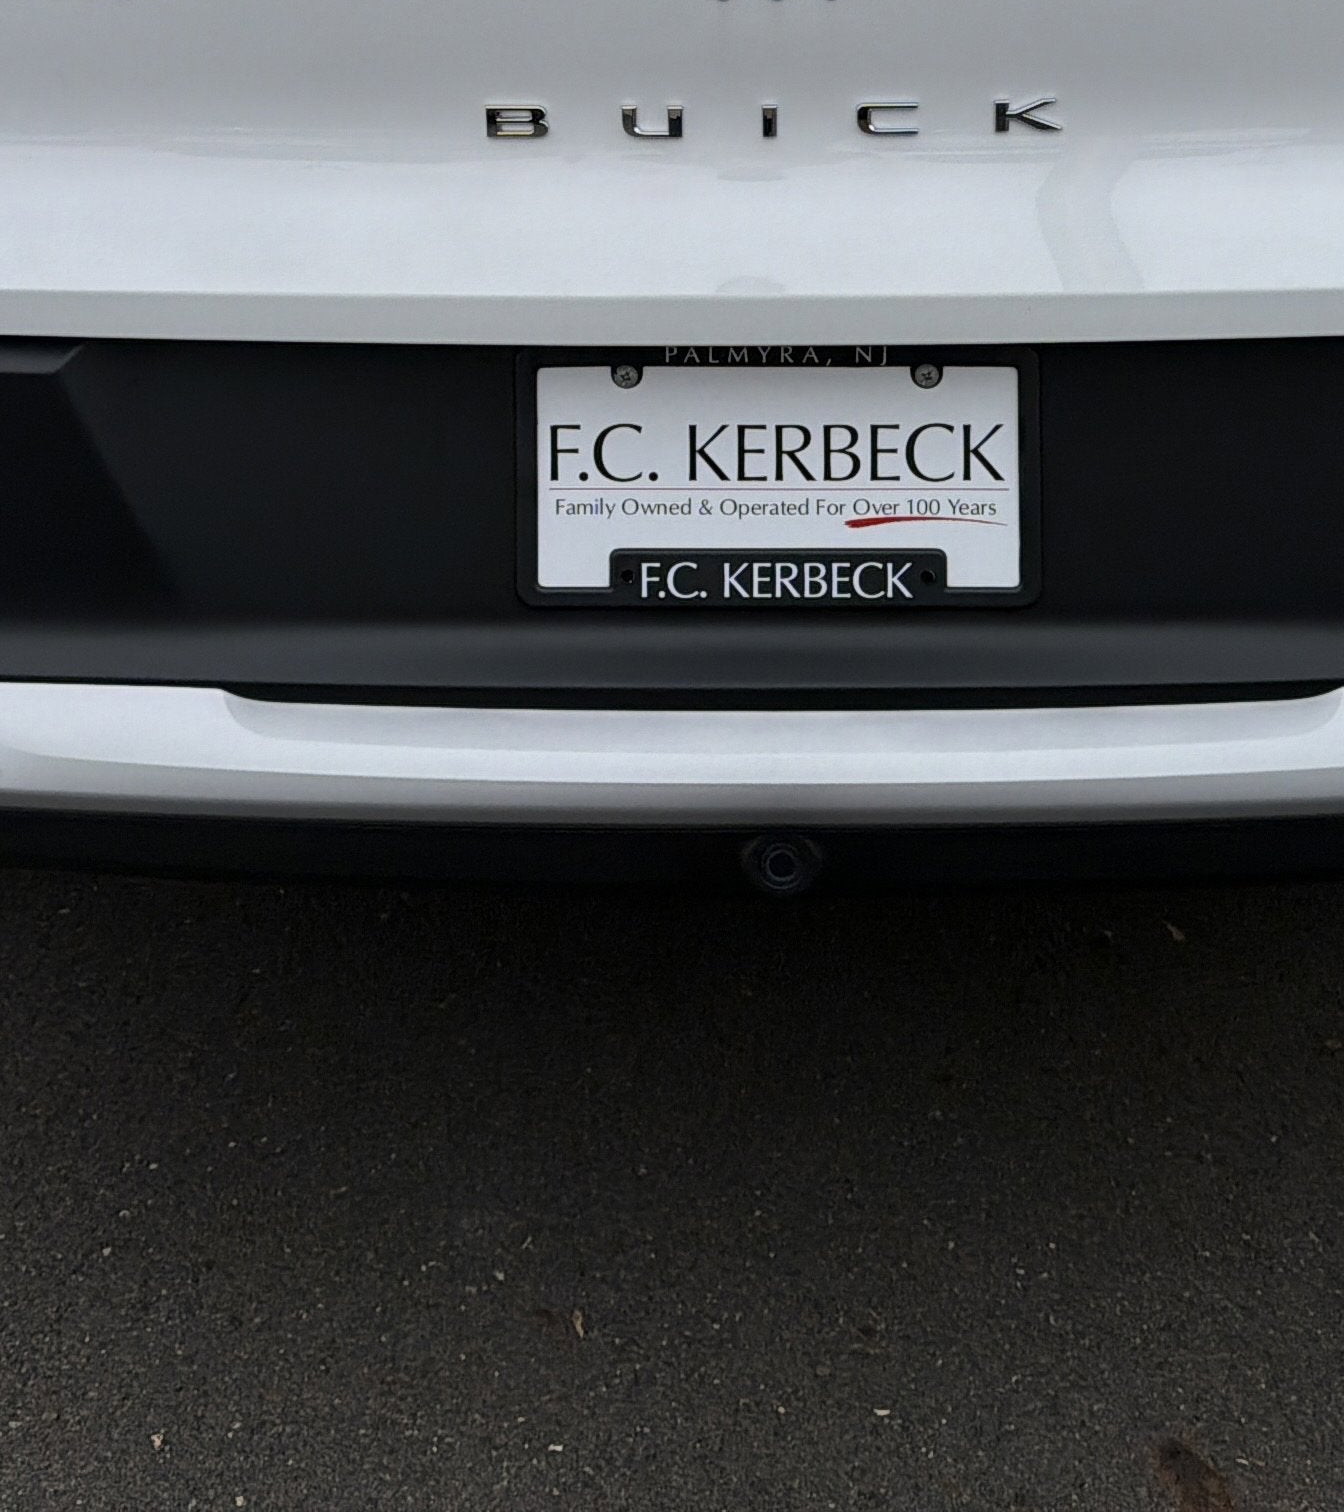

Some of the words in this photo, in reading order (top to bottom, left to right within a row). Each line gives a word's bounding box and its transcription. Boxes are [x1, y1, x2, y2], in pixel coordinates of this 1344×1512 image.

[485, 98, 1062, 138] BUICK
[666, 347, 831, 365] PALMYRA,
[856, 347, 886, 365] NJ
[550, 424, 658, 482] F.C.
[689, 423, 1004, 482] KERBECK
[556, 498, 615, 518] Family
[622, 498, 691, 515] Owned
[699, 500, 712, 515] &
[720, 498, 809, 519] Operated
[817, 499, 845, 515] For
[853, 499, 899, 515] Over
[908, 499, 940, 515] 100
[948, 499, 996, 515] Years
[642, 562, 706, 598] F.C.
[724, 562, 912, 598] KERBECK
